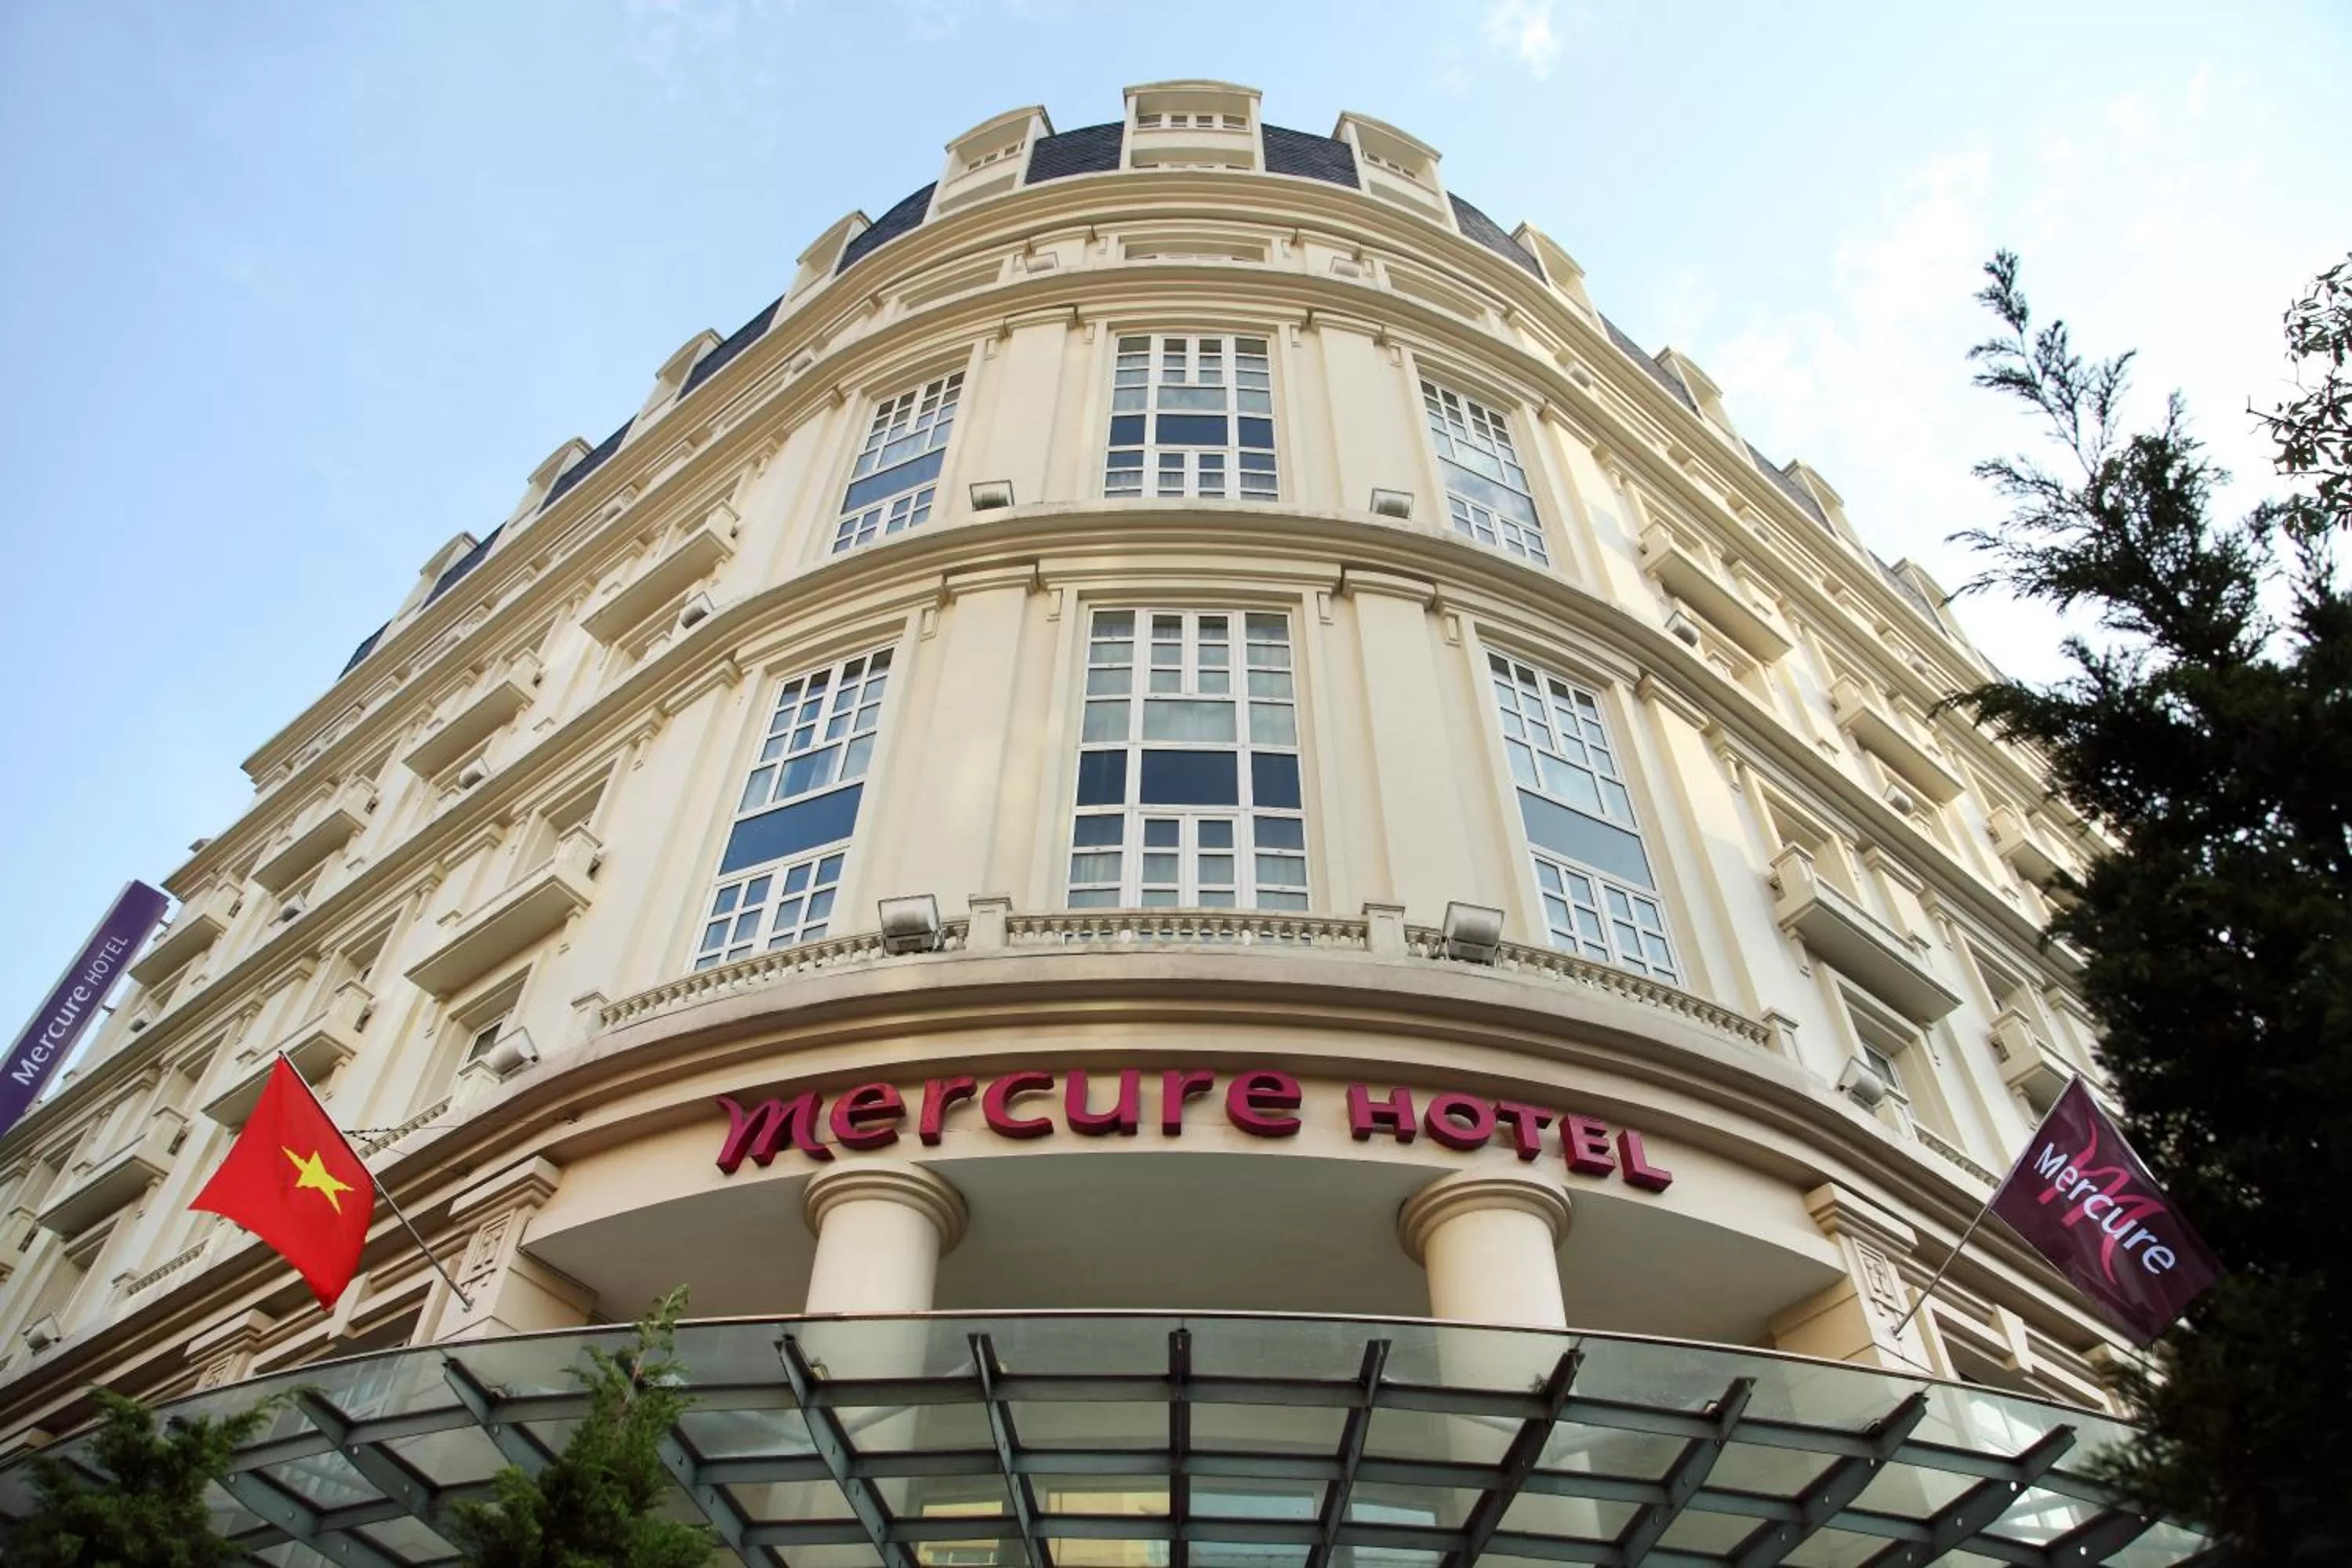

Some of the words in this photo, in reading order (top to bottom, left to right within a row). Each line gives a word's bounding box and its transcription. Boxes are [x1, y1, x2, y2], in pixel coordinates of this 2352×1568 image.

[12, 985, 91, 1085] Mercure
[84, 935, 129, 986] HOTEL
[1346, 1083, 1673, 1193] HOTEL
[2034, 1142, 2176, 1276] Mercure
